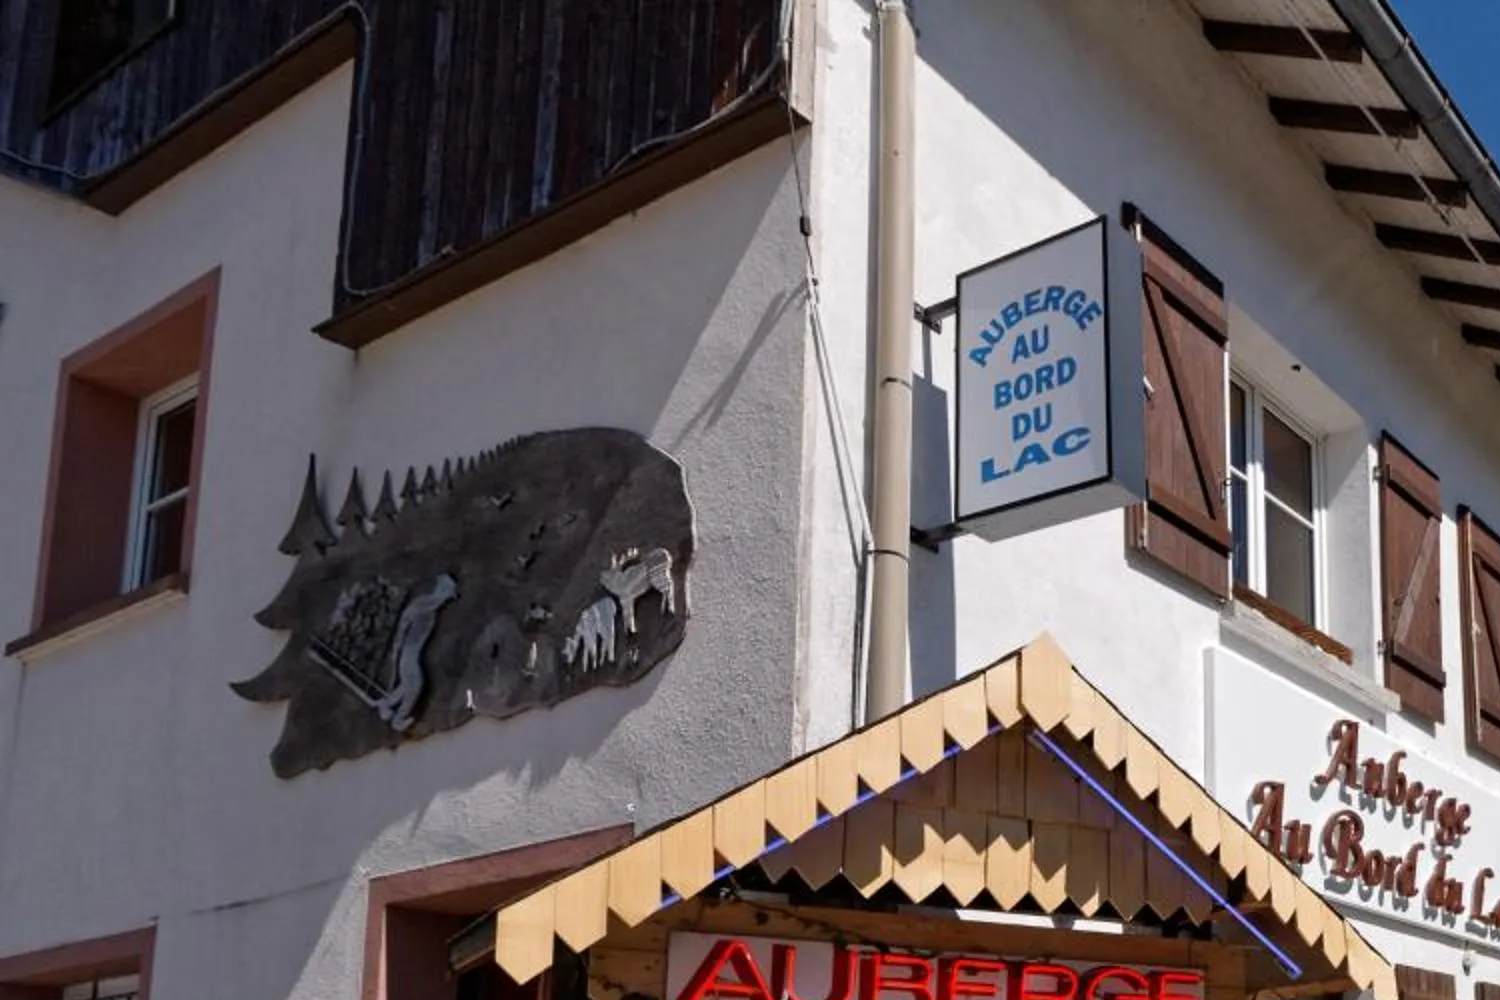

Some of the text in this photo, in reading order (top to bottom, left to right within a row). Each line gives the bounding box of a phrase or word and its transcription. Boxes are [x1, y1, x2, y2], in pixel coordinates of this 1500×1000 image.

[969, 285, 1103, 368] AUBERGE
[1011, 324, 1050, 364] AU
[993, 356, 1077, 410] BORD
[1012, 403, 1053, 442] DU
[979, 426, 1092, 484] LAC
[1312, 719, 1472, 846] Auberge
[1250, 781, 1313, 865] Au
[1321, 809, 1425, 898] Bord
[1424, 854, 1466, 914] du
